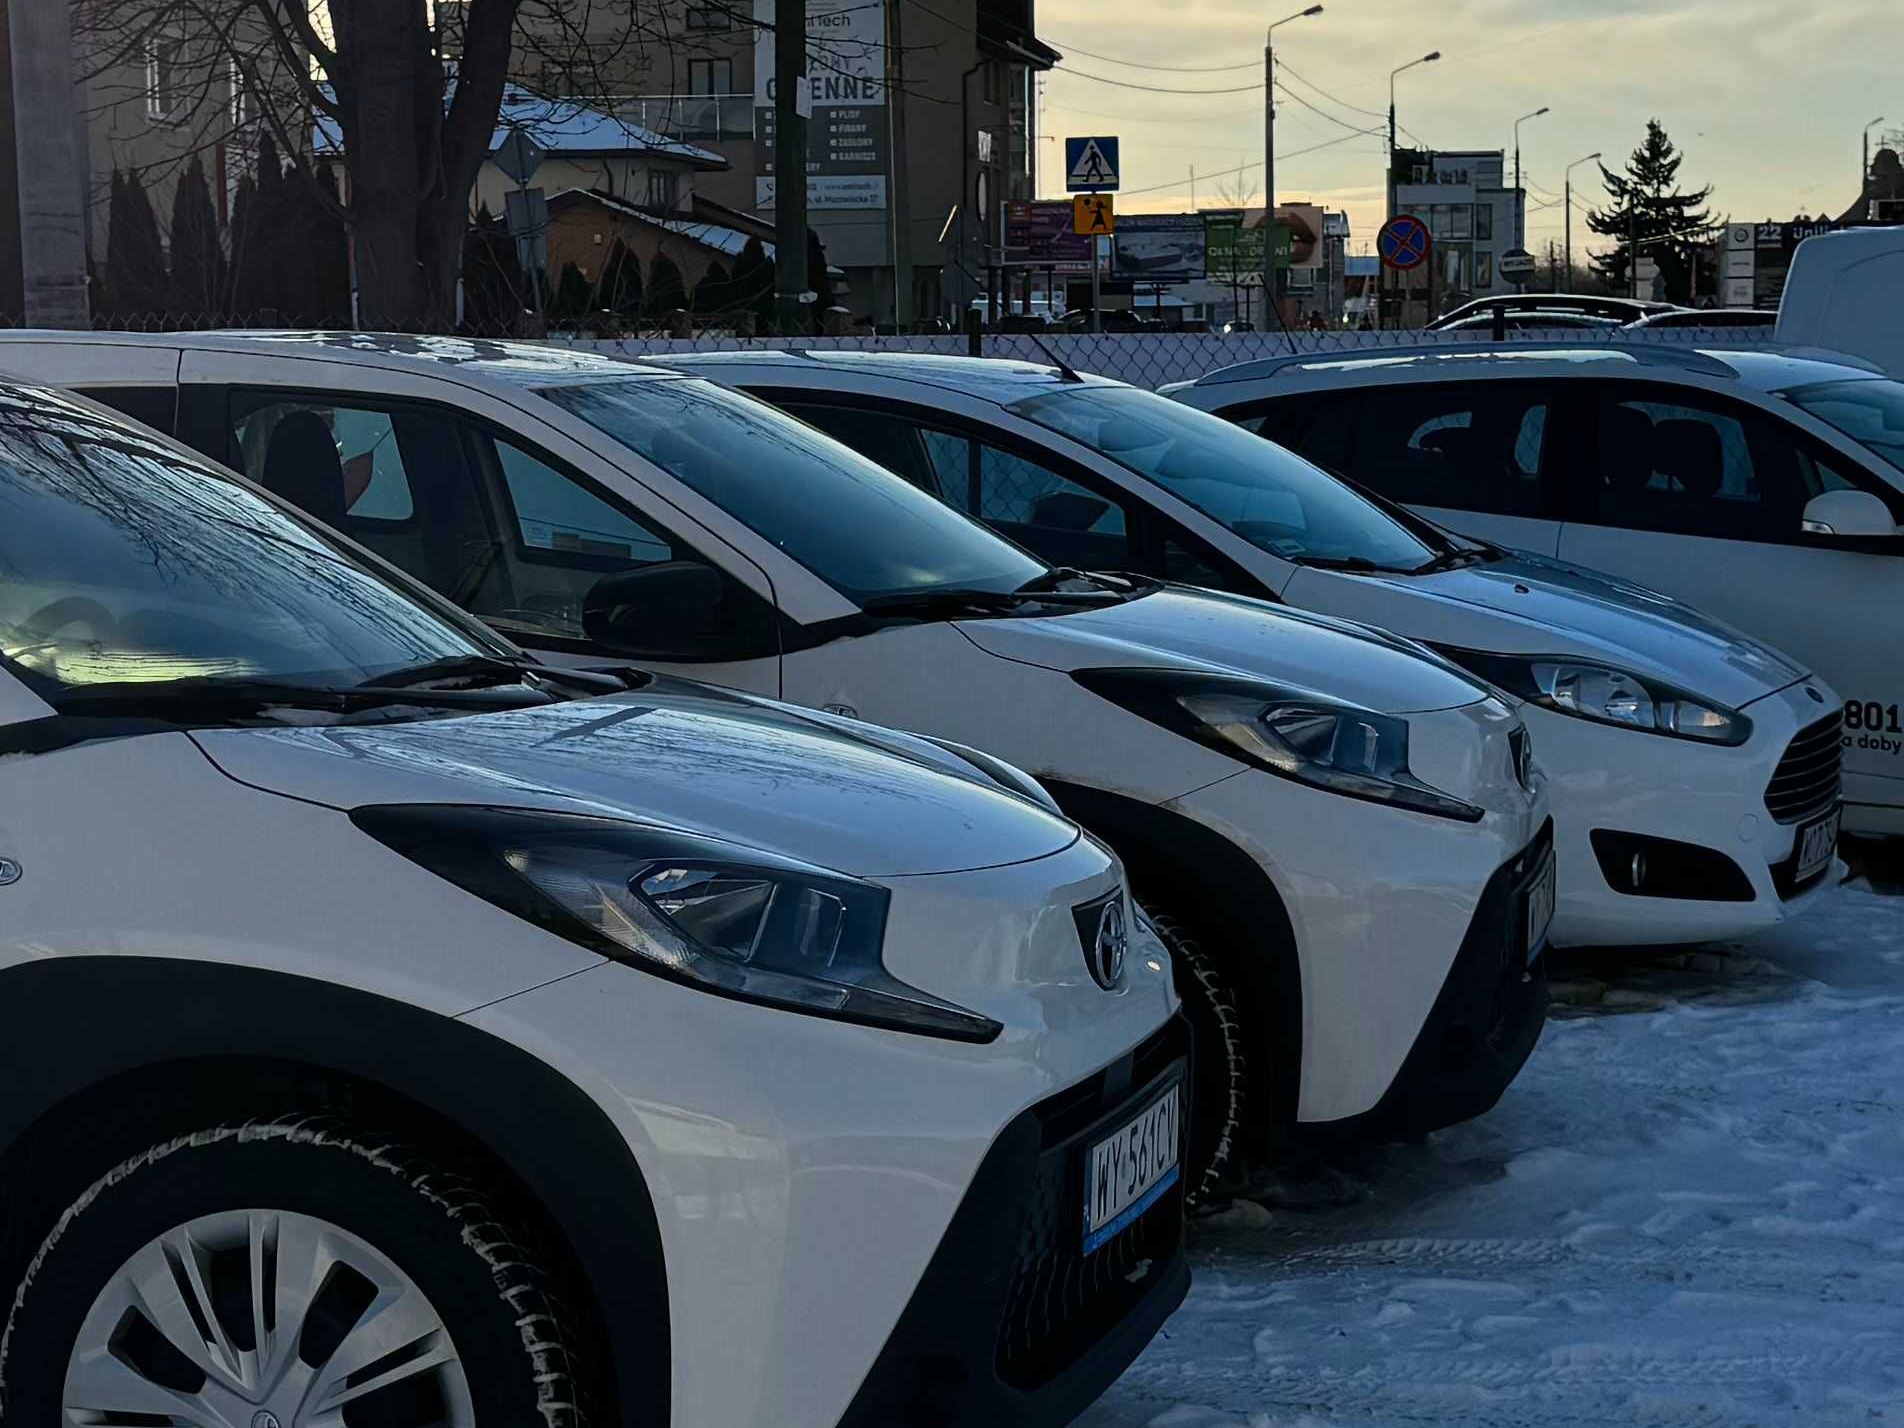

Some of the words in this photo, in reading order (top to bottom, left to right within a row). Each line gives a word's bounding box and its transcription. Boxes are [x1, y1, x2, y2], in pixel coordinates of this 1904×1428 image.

[1844, 700, 1902, 733] 801
[1858, 734, 1902, 755] doby
[1097, 1135, 1122, 1221] WY
[1128, 1094, 1177, 1196] 561CV
